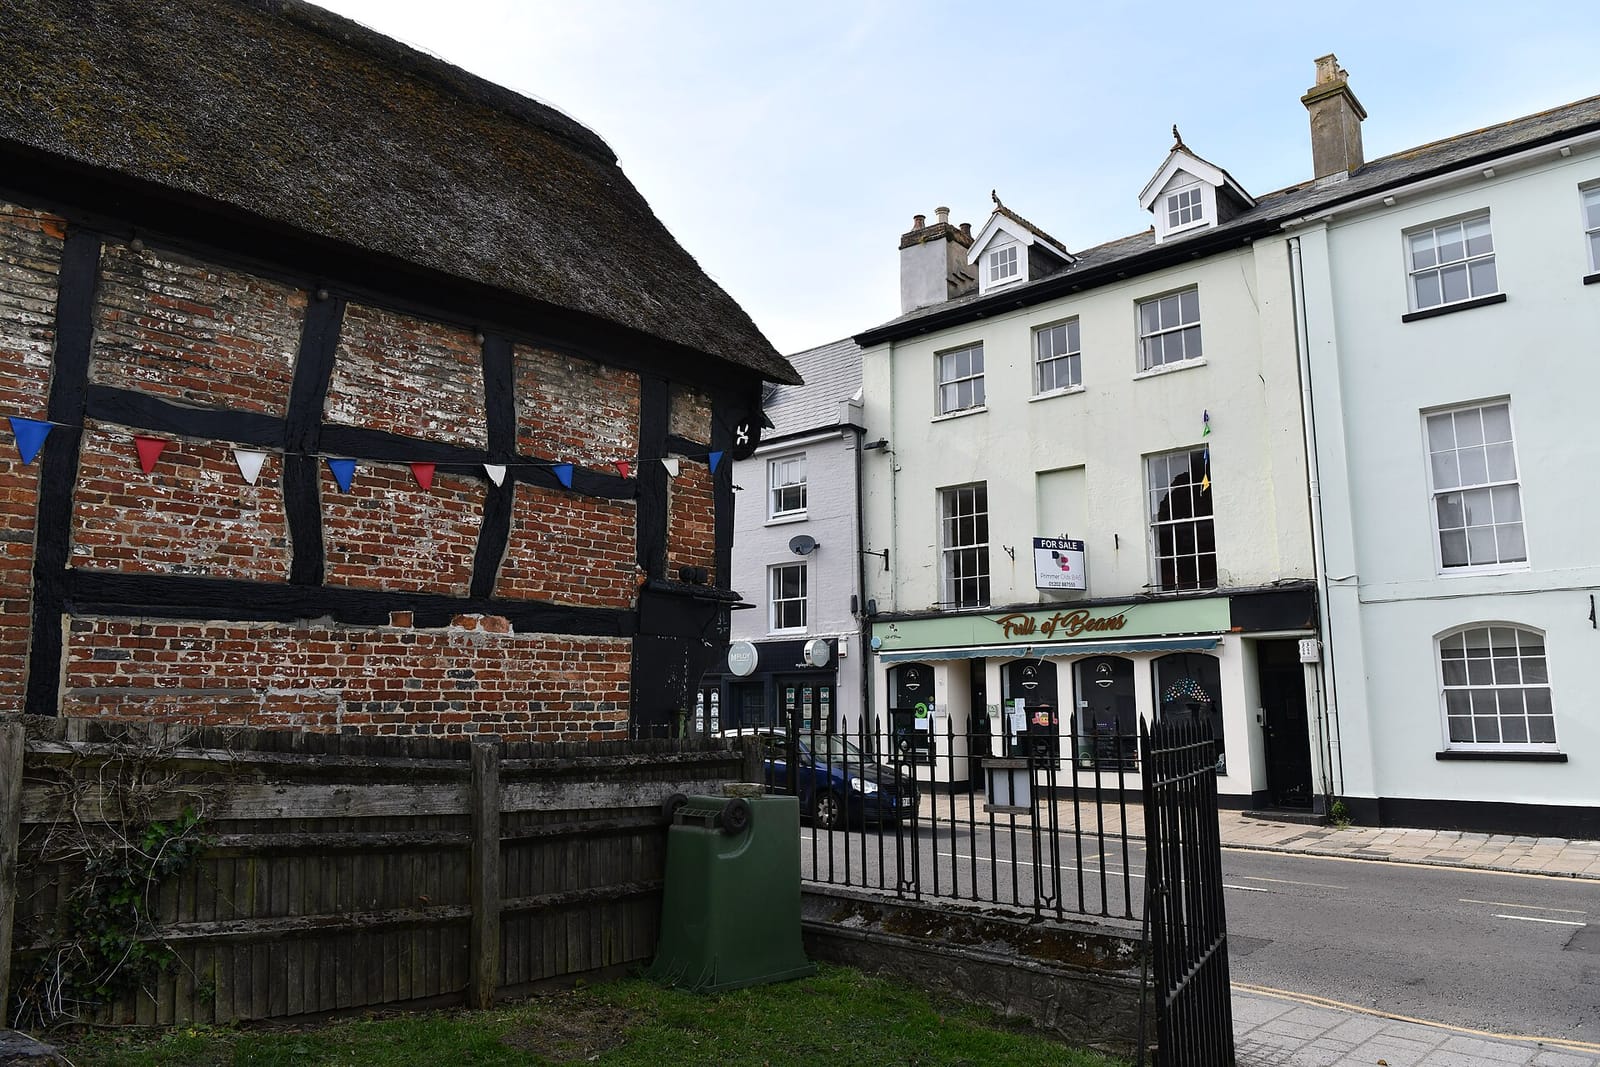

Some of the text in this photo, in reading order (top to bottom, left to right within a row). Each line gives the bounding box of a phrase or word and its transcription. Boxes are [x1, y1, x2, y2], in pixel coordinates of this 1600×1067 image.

[1041, 540, 1078, 550] FOR SALE
[996, 610, 1128, 639] Full of Beans
